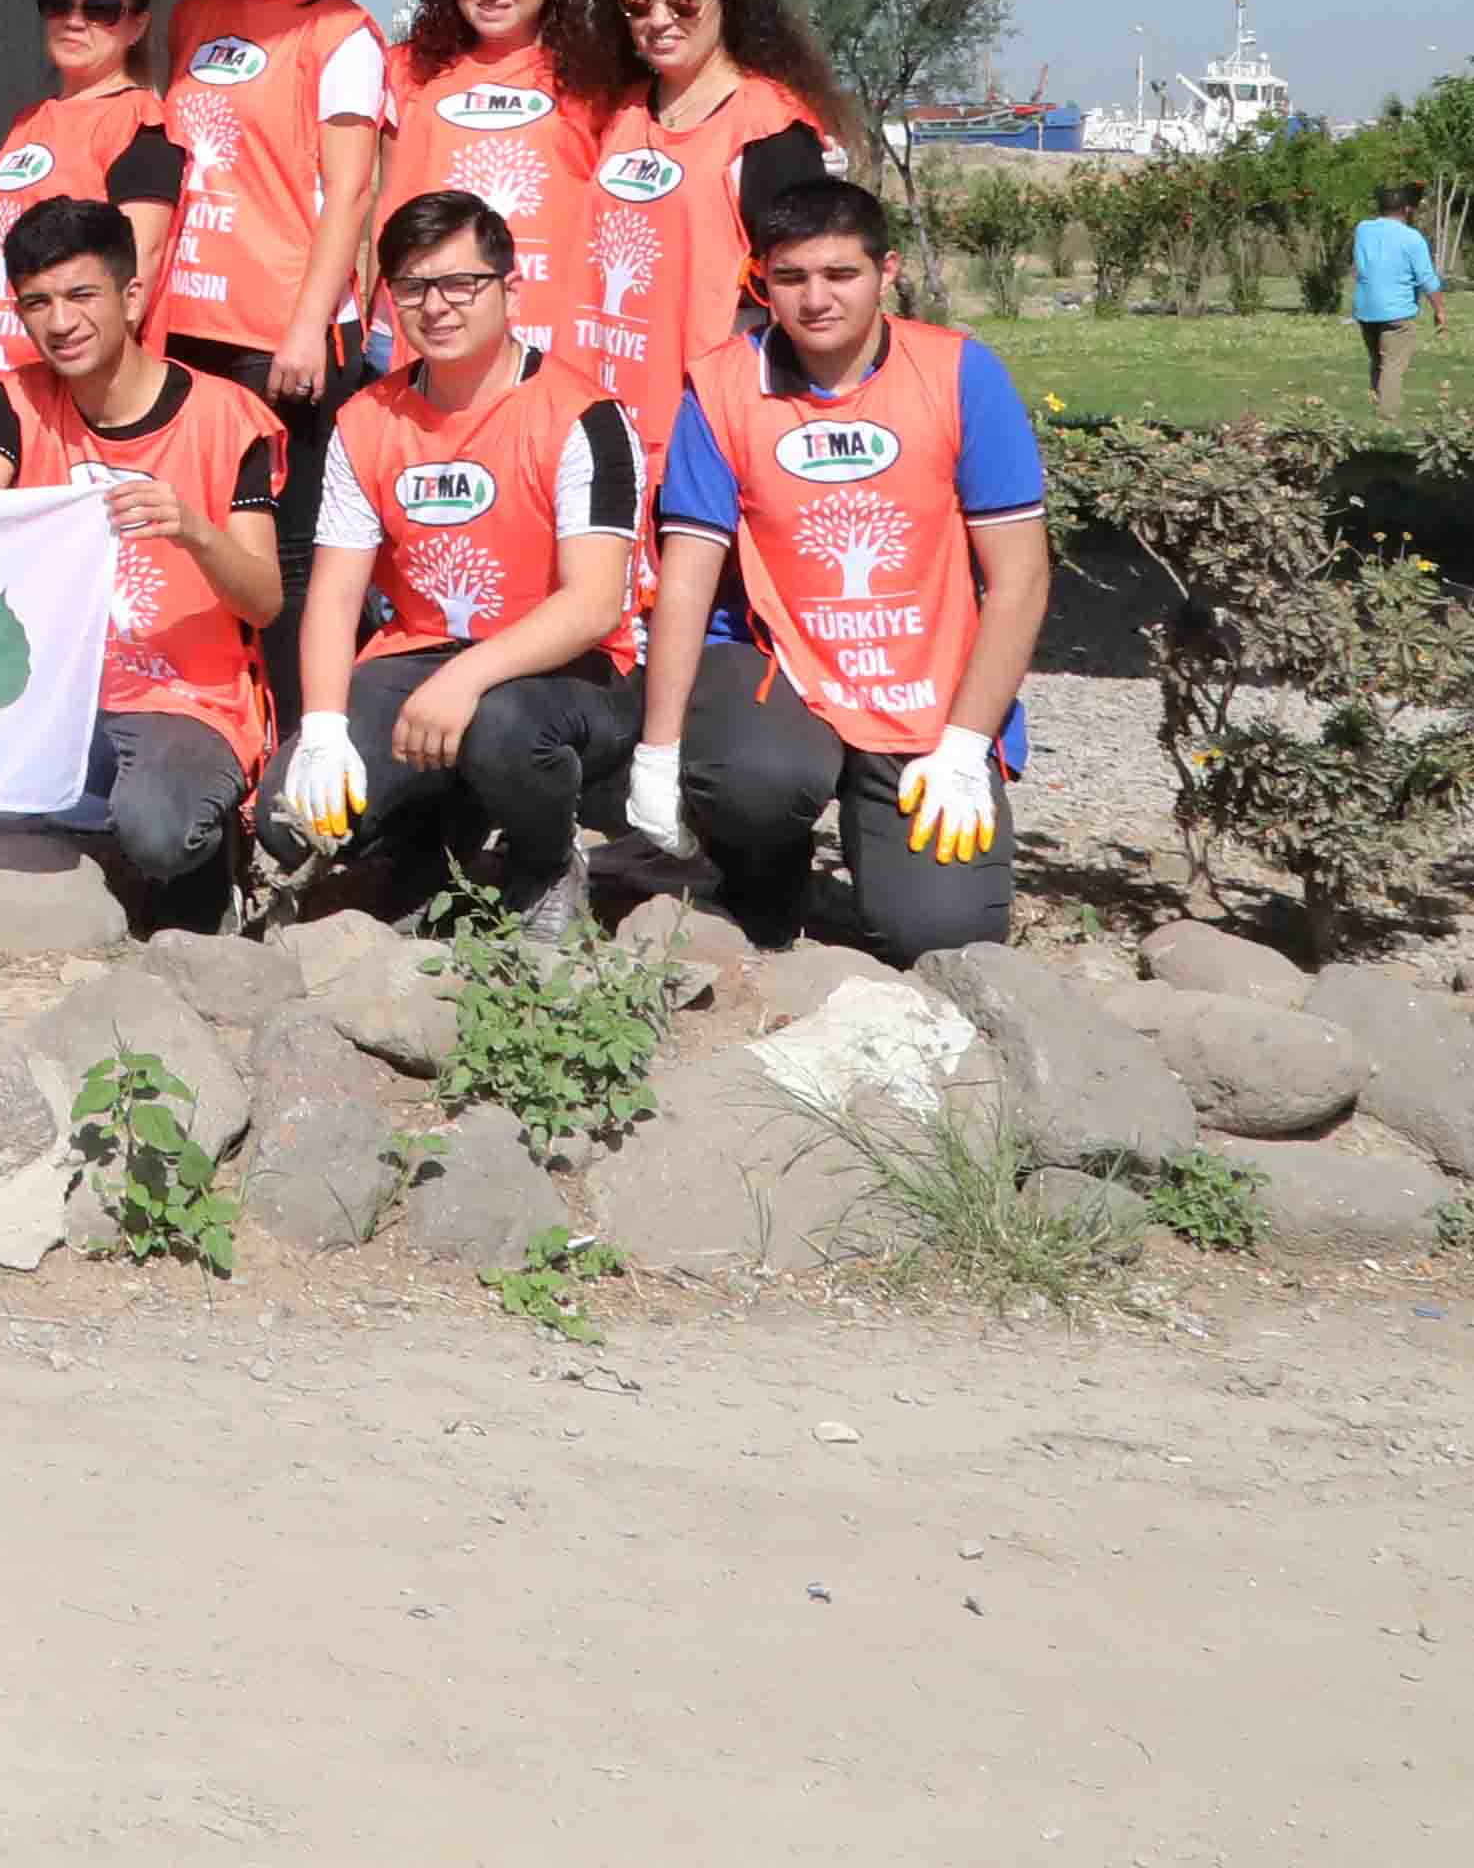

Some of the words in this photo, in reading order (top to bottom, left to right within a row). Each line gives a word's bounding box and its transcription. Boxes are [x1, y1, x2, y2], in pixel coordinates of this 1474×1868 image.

[463, 92, 522, 111] TEMA
[802, 430, 866, 460] TEMA
[413, 473, 472, 501] TEMA
[799, 602, 925, 642] TÜRKİYE
